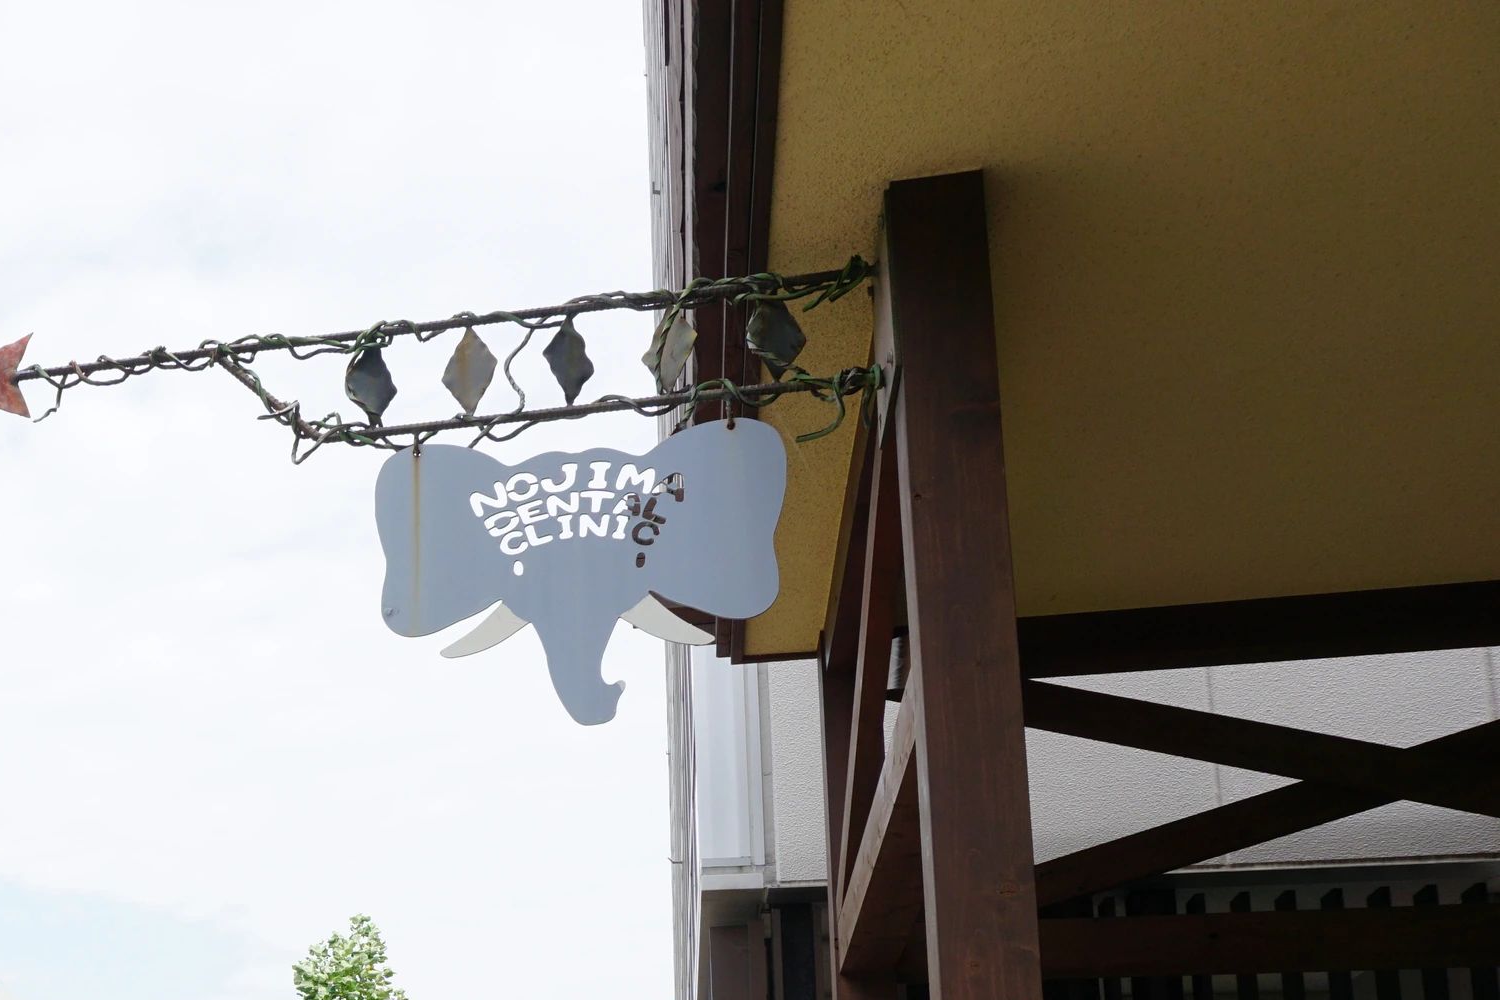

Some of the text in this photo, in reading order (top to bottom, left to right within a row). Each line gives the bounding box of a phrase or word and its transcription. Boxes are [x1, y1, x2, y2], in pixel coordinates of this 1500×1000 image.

[469, 461, 685, 518] NOJIMA
[483, 490, 667, 537] DENTAL
[499, 515, 660, 555] CLINIC
